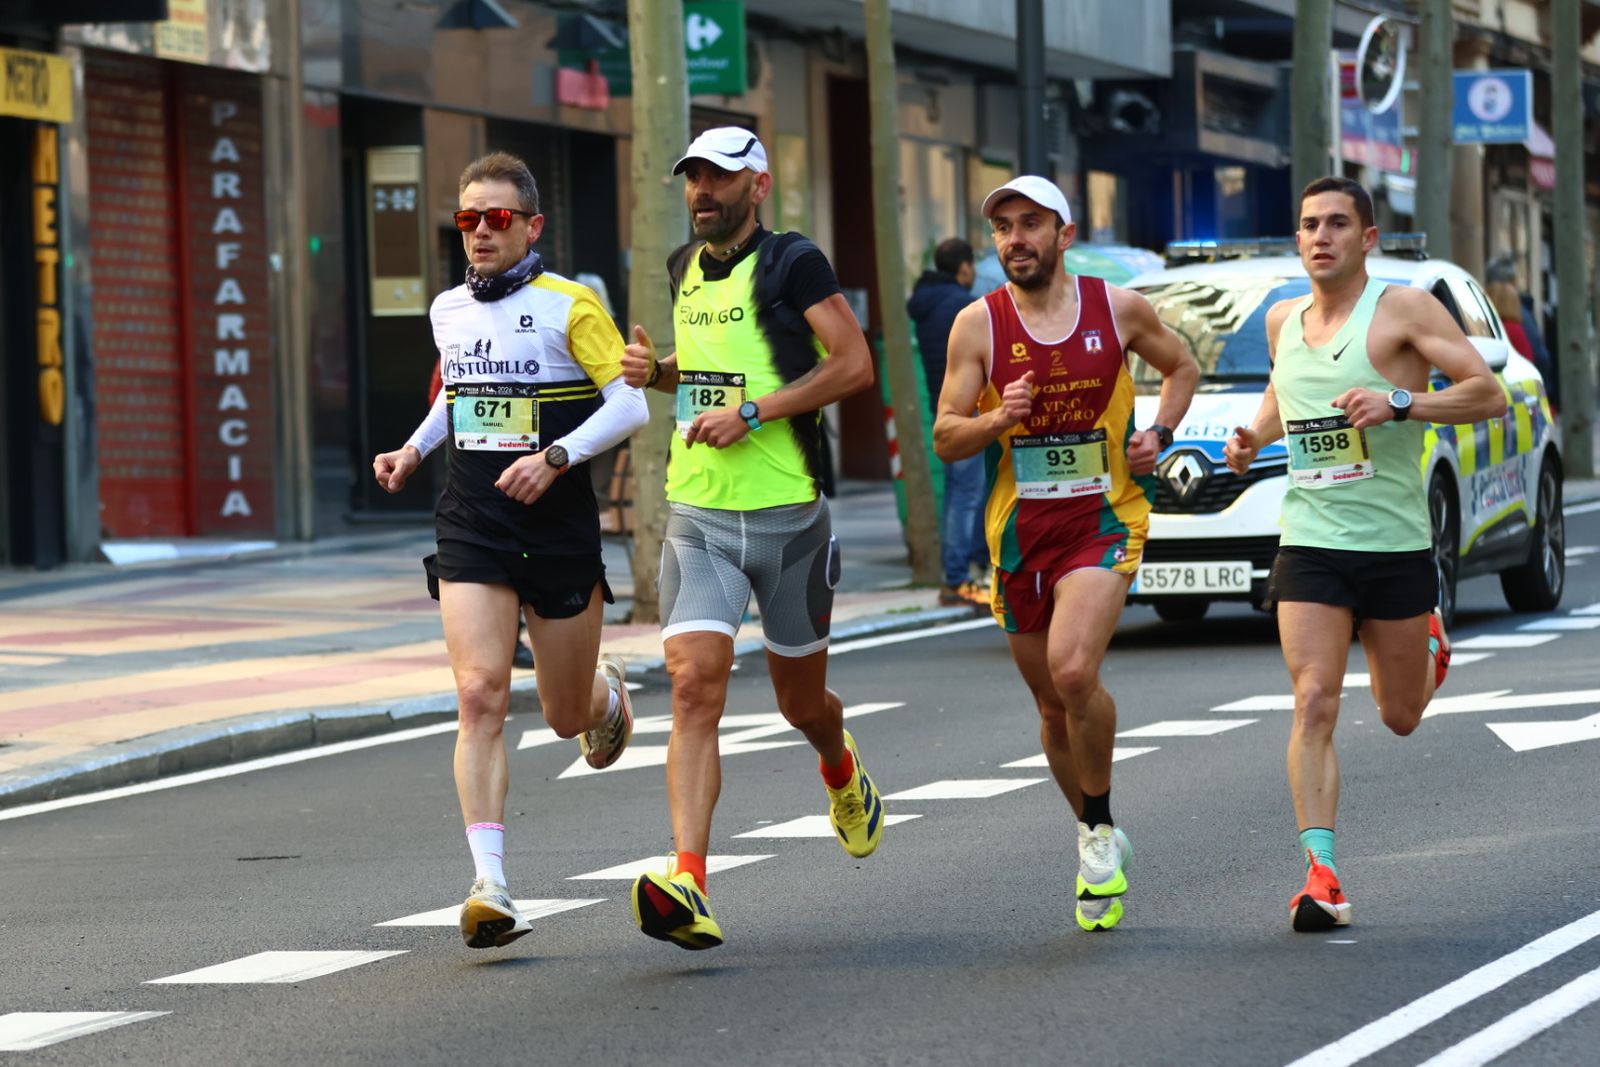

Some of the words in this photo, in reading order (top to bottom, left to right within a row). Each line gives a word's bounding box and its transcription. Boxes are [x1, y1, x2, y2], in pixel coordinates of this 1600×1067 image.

[33, 126, 64, 425] METRO
[210, 103, 251, 517] PARAFARMACIA
[1069, 378, 1103, 391] RURAL
[689, 388, 726, 407] 182
[1043, 397, 1081, 412] VINO
[474, 400, 511, 418] 671
[1031, 415, 1050, 427] DE
[1054, 409, 1095, 424] TORO
[1299, 433, 1350, 454] 1598
[1046, 449, 1076, 467] 93
[1142, 568, 1196, 588] 5578
[1204, 567, 1245, 588] LRC
